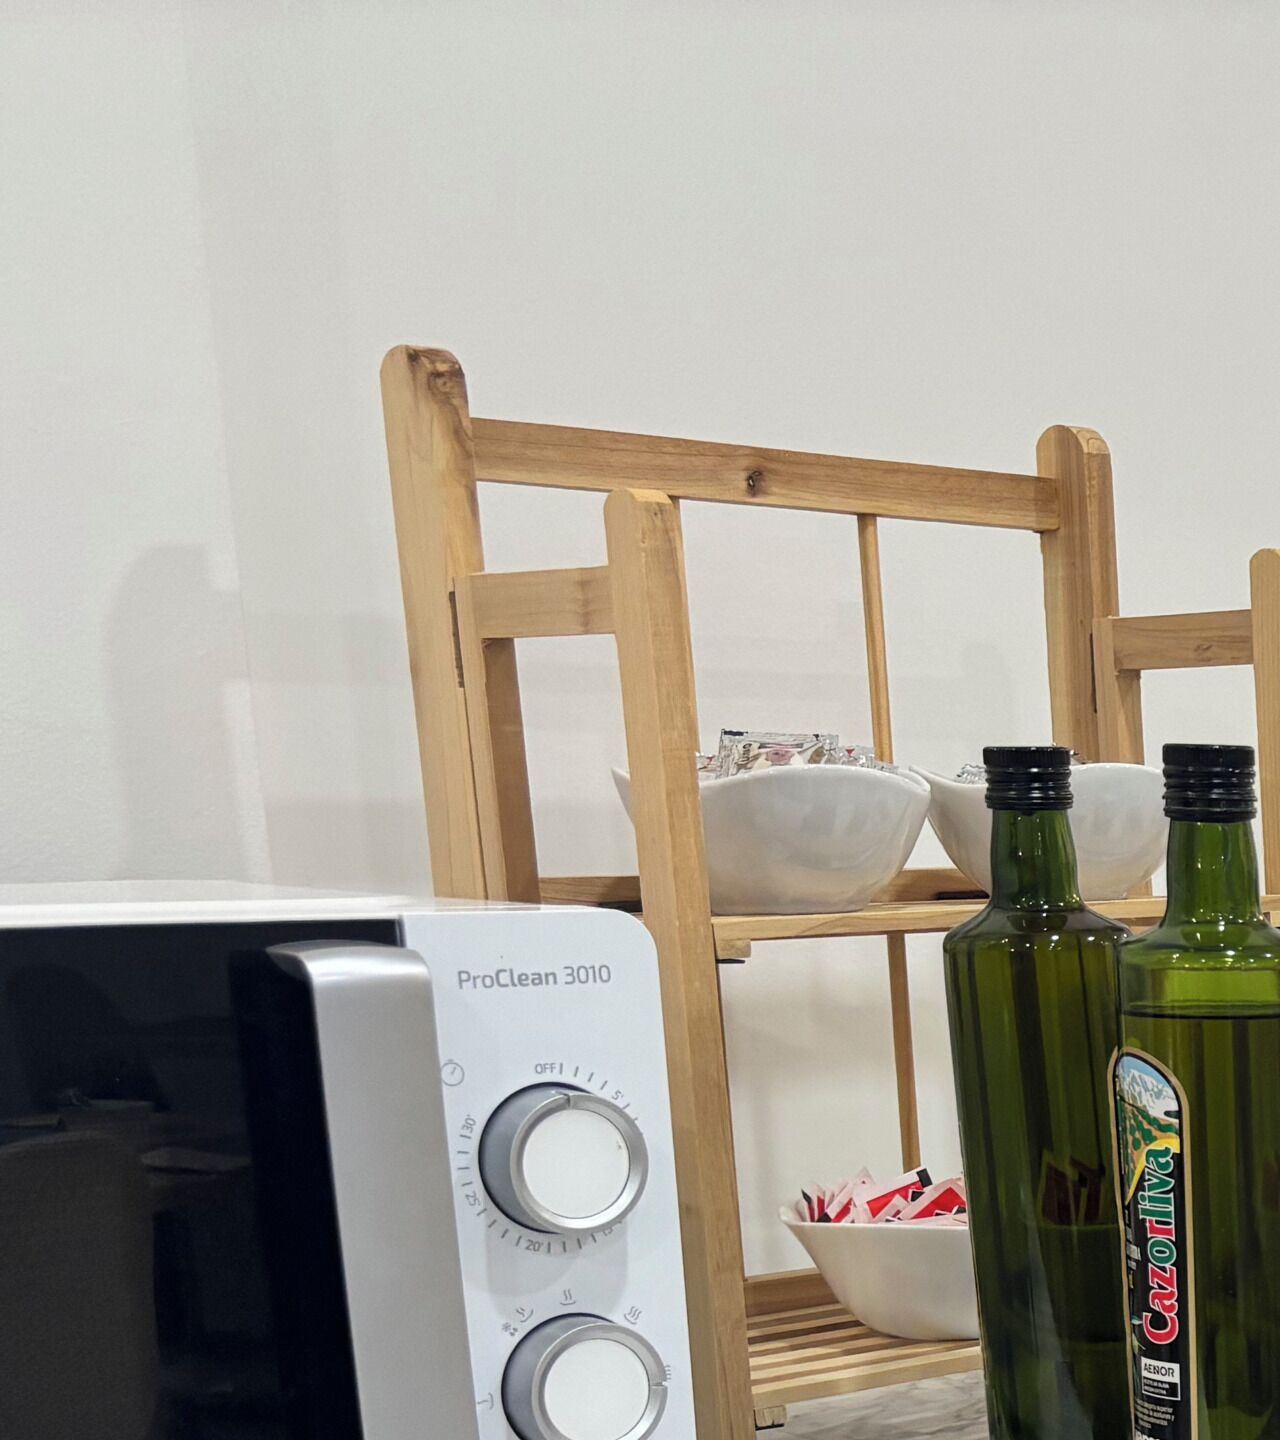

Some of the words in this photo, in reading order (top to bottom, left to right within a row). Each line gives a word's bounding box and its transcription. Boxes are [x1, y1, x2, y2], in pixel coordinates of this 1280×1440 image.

[457, 968, 558, 989] ProClean
[564, 964, 612, 985] 3010
[535, 1063, 557, 1075] OFF
[1139, 1146, 1179, 1345] Cazorliva
[1143, 1362, 1175, 1378] AENOR
